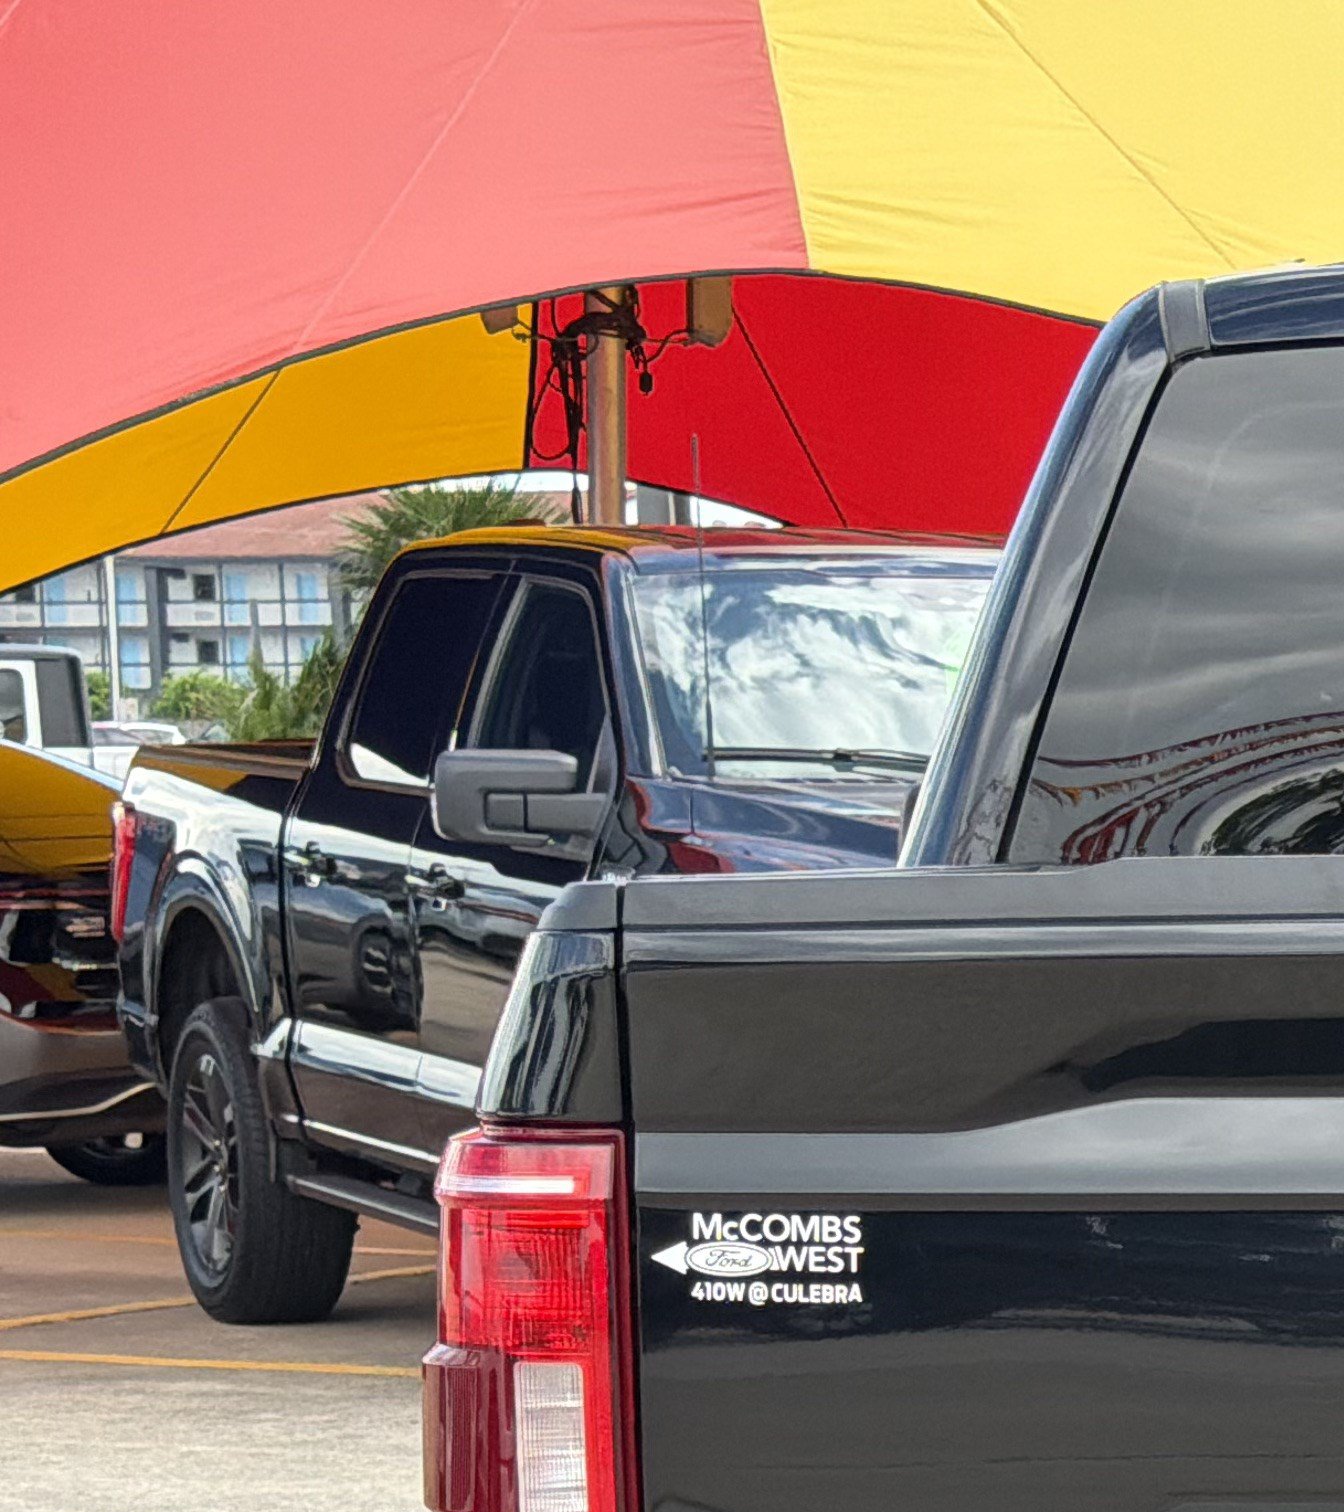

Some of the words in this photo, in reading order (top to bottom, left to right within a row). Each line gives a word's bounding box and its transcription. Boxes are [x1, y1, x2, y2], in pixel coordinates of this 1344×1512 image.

[692, 1212, 862, 1244] McCOMBS
[705, 1249, 753, 1268] Ford
[775, 1246, 865, 1273] WEST
[691, 1282, 746, 1301] 410W
[771, 1283, 863, 1304] CULEBRA
